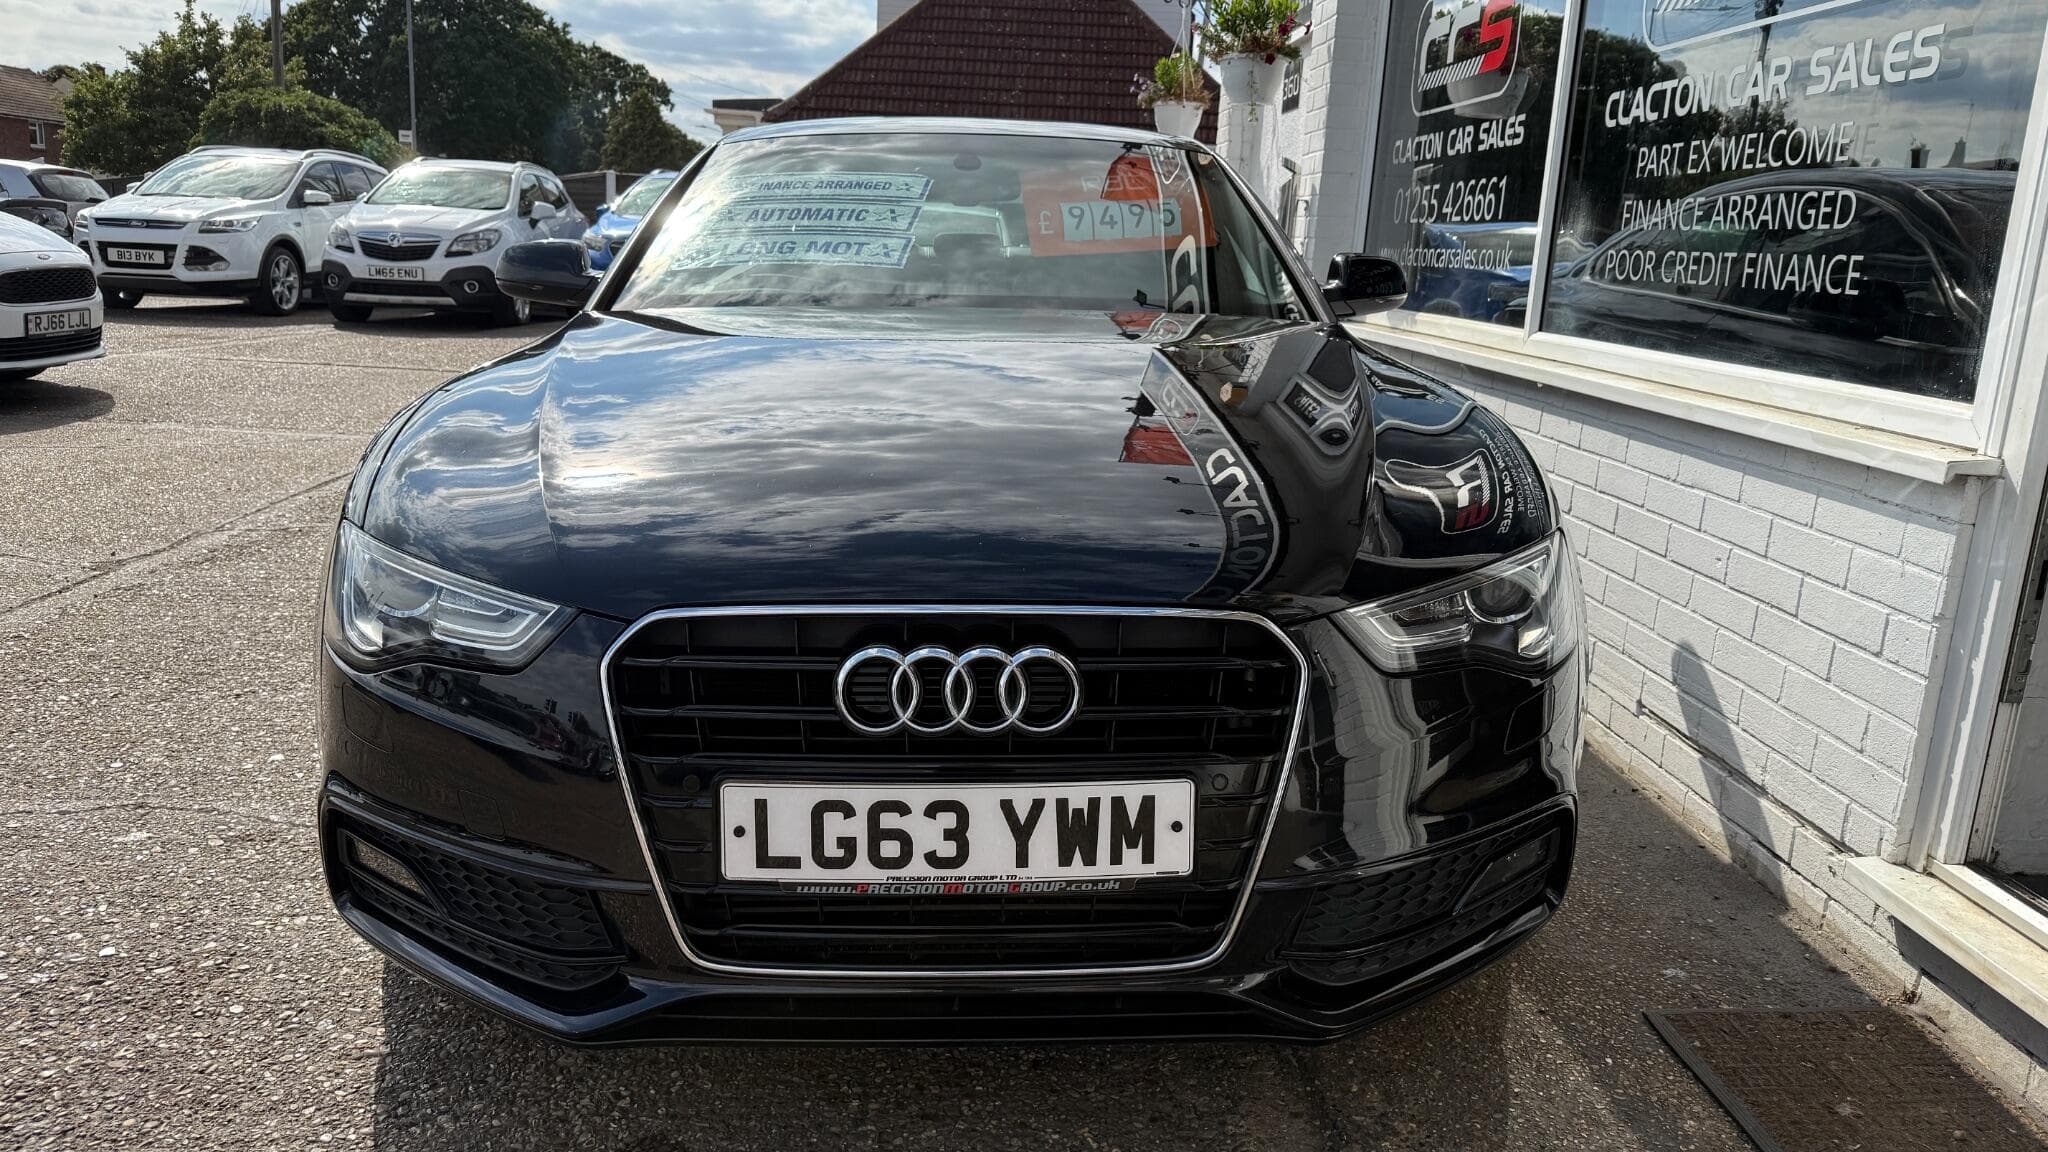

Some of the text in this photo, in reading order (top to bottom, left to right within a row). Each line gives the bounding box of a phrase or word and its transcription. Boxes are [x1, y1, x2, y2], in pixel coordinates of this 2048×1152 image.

[1605, 23, 1946, 128] CLACTON CAR SALES
[1392, 113, 1527, 165] CLACTON CAR SALES
[1635, 120, 1856, 179] PART EX WELCOME
[814, 180, 893, 192] ARRANGED
[1393, 175, 1508, 224] 01255 426661
[745, 206, 870, 223] AUTOMATIC
[1067, 202, 1177, 231] 9495
[1621, 189, 1857, 232] FINANCE ARRANGED
[135, 251, 155, 261] BYK
[806, 241, 869, 257] MOT
[368, 267, 418, 279] LM65 ENU
[1604, 249, 1865, 296] POOR CREDIT FINANCE
[34, 311, 89, 333] RJ66 LJL
[753, 794, 1157, 870] LG63 YWM
